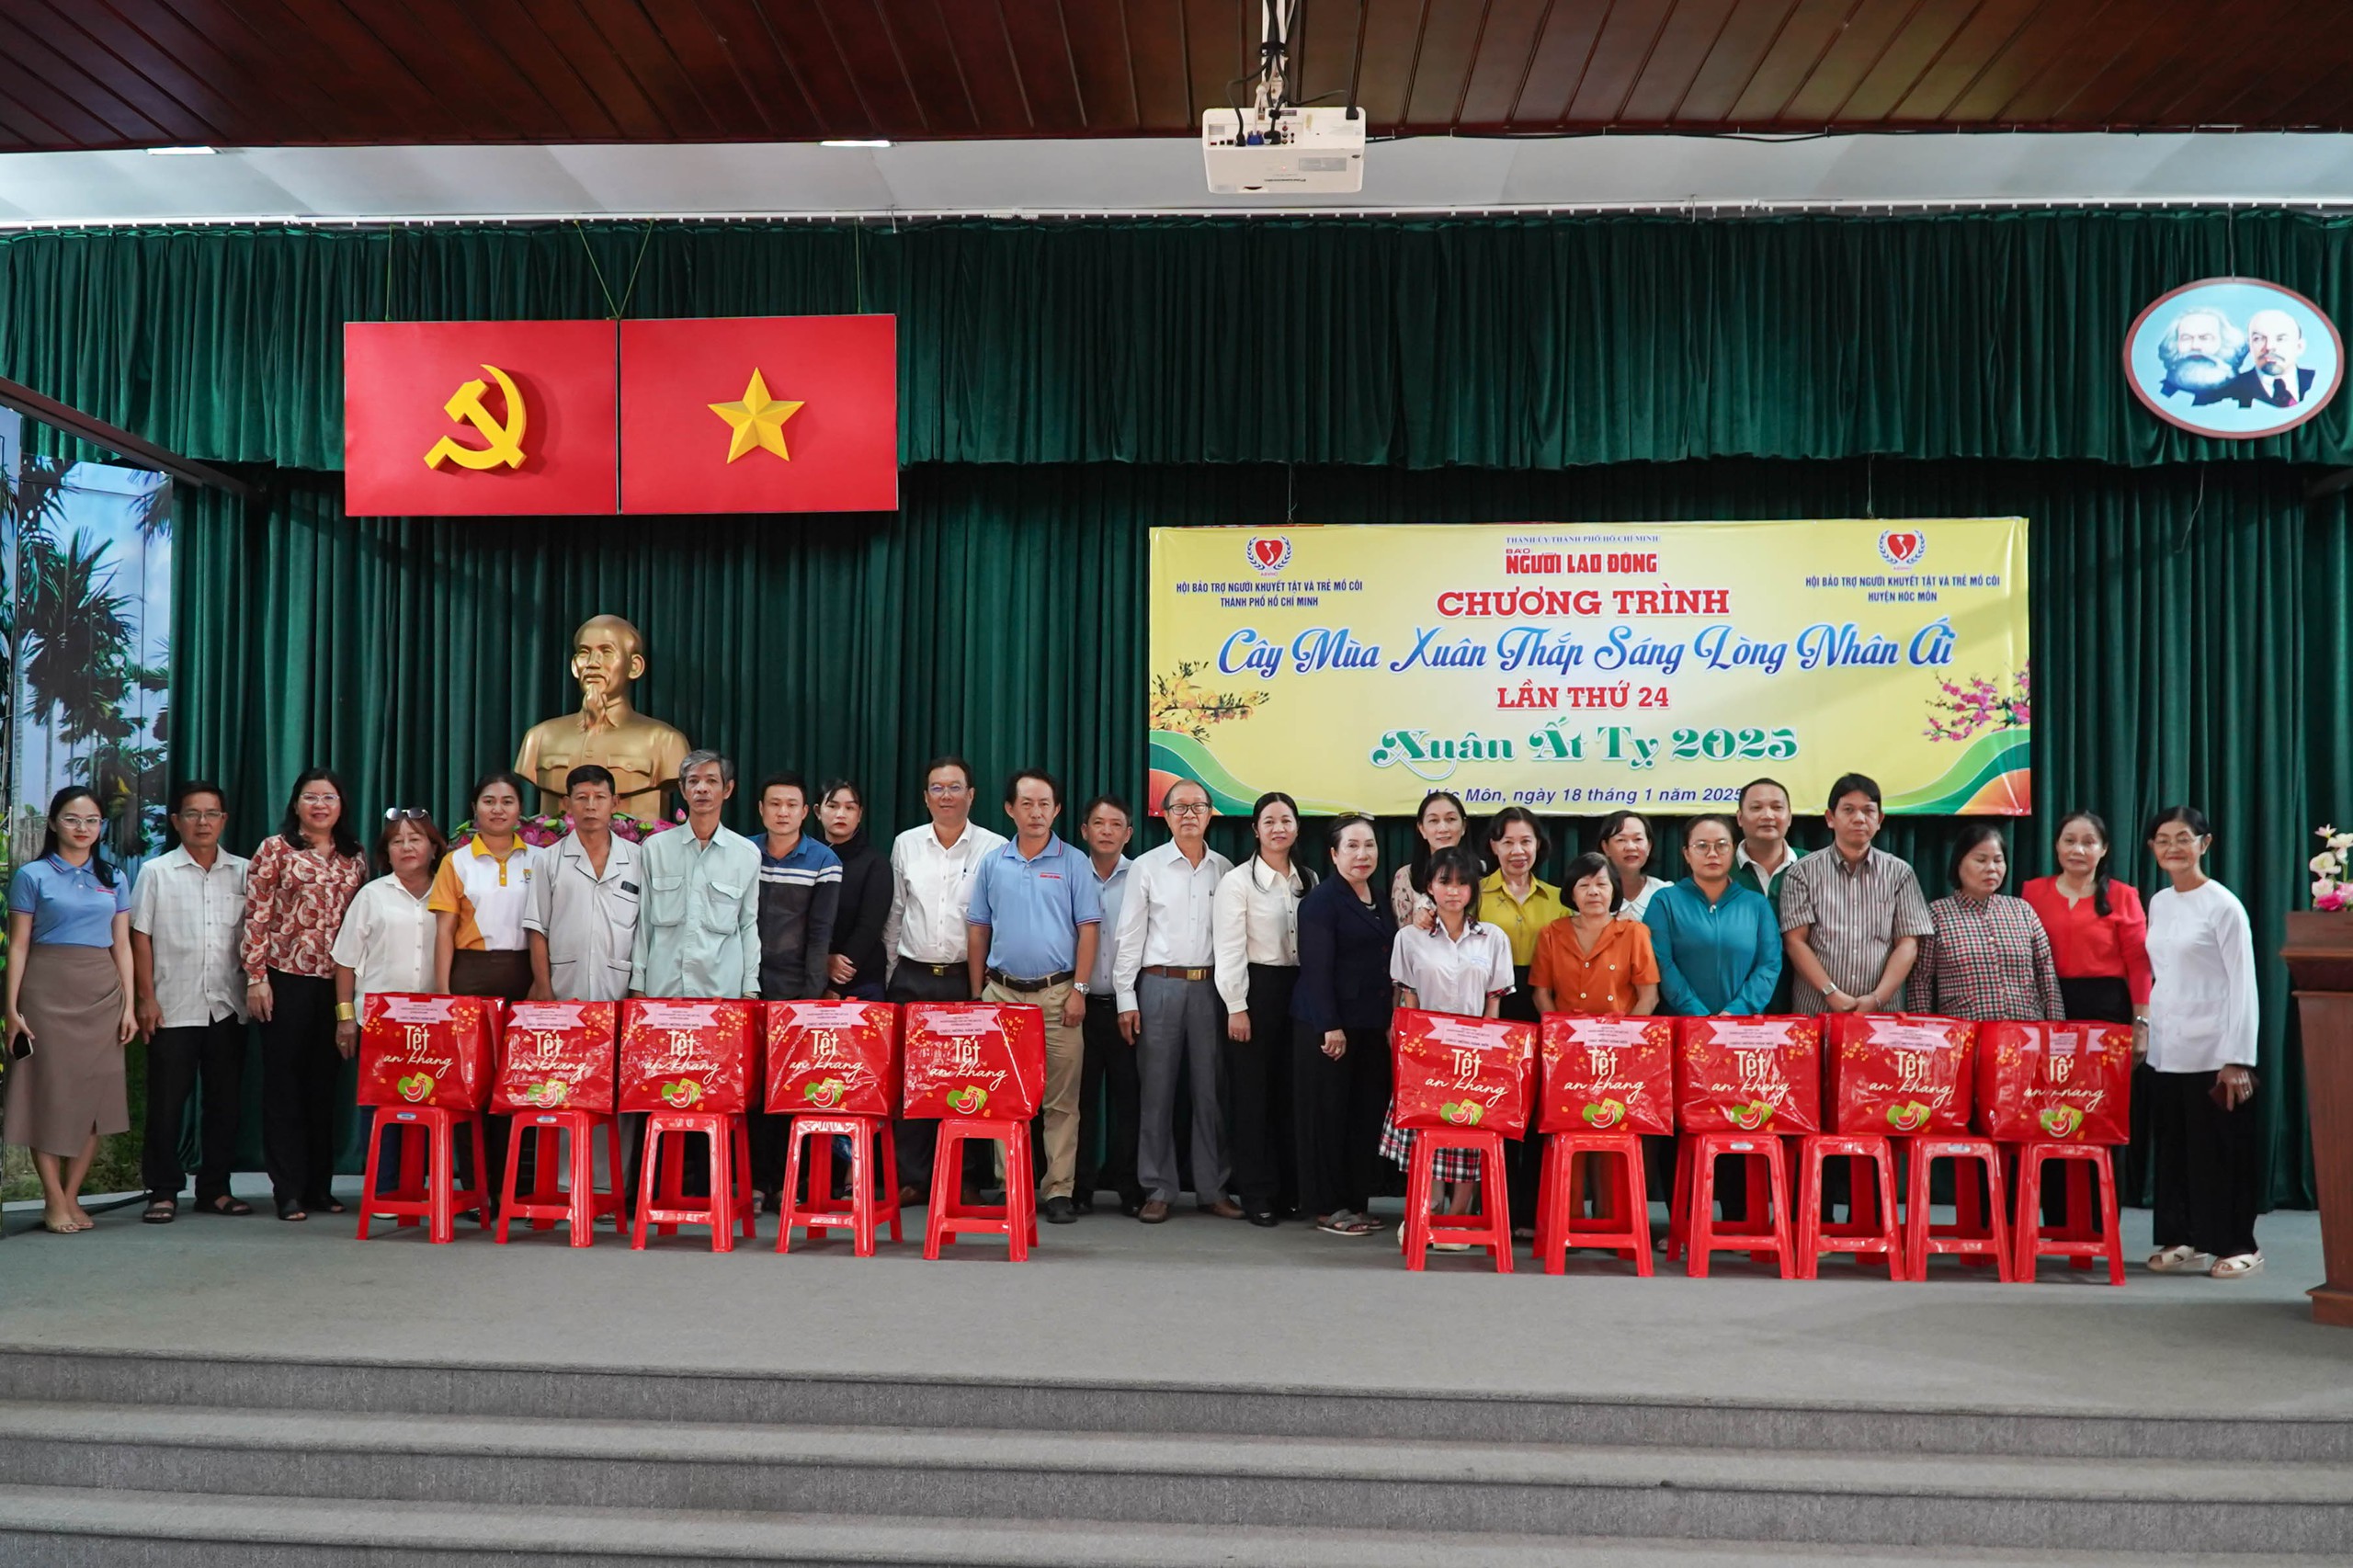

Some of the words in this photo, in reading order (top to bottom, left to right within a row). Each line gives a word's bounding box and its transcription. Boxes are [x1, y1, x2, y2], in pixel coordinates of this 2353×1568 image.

[1567, 553, 1602, 574] LAO
[1607, 551, 1657, 574] ĐỘNG
[1176, 581, 1190, 594] HỘI
[1211, 581, 1226, 594] TRỢ
[1228, 580, 1253, 593] NGƯỜI
[1256, 579, 1286, 593] KHUYẾT
[1288, 581, 1302, 595] TẬT
[1349, 578, 1363, 591] CÔI
[1805, 575, 1820, 588] HỘI
[1842, 575, 1858, 588] TRỢ
[1986, 574, 2000, 586] CÔI
[1280, 593, 1294, 607] CHÍ
[1297, 595, 1319, 607] MINH
[1438, 585, 1602, 617] CHƯƠNG
[1612, 583, 1730, 614] TRÌNH
[1868, 591, 1896, 604] HUYỆN
[1219, 629, 1284, 678] Cây
[1291, 628, 1381, 674] Mùa
[1390, 626, 1487, 673] Xuân
[1497, 626, 1583, 676] Thắp
[1594, 625, 1686, 675] Sáng
[1693, 624, 1789, 675] Lòng
[1797, 623, 1900, 670] Nhân
[1908, 617, 1956, 665] Ái
[1497, 678, 1559, 709] LẦN
[1567, 678, 1630, 708] THỨ
[1639, 687, 1668, 708] 24
[1371, 731, 1514, 779] Xuân
[1529, 716, 1585, 760] Ất
[1597, 726, 1659, 768] Tỵ
[1671, 727, 1797, 762] 2025
[1465, 788, 1507, 803] Môn,
[1513, 788, 1557, 805] ngày
[1563, 788, 1582, 802] 18
[1587, 787, 1638, 805] tháng
[1645, 788, 1653, 801] 1
[1659, 788, 1697, 801] năm
[404, 1024, 430, 1051] Tết
[531, 1029, 563, 1057] Tết
[667, 1029, 697, 1056] Tết
[811, 1028, 839, 1056] Tết
[952, 1036, 981, 1064] Tết
[383, 1054, 404, 1063] an
[406, 1050, 453, 1080] khang
[510, 1061, 533, 1071] an
[538, 1056, 588, 1084] khang
[643, 1061, 664, 1071] an
[669, 1056, 722, 1085] khang
[790, 1061, 809, 1071] an
[813, 1055, 865, 1084] khang
[1451, 1048, 1483, 1077] Tết
[1587, 1047, 1618, 1076] Tết
[1733, 1048, 1767, 1078] Tết
[1894, 1050, 1927, 1079] Tết
[929, 1067, 950, 1077] an
[956, 1062, 1009, 1091] khang
[1425, 1077, 1449, 1088] an
[1453, 1074, 1508, 1108] khang
[1563, 1079, 1586, 1091] an
[1592, 1074, 1646, 1105] khang
[1711, 1081, 1734, 1092] an
[1740, 1076, 1790, 1107] khang
[1869, 1081, 1893, 1092] an
[1898, 1076, 1954, 1109] khang
